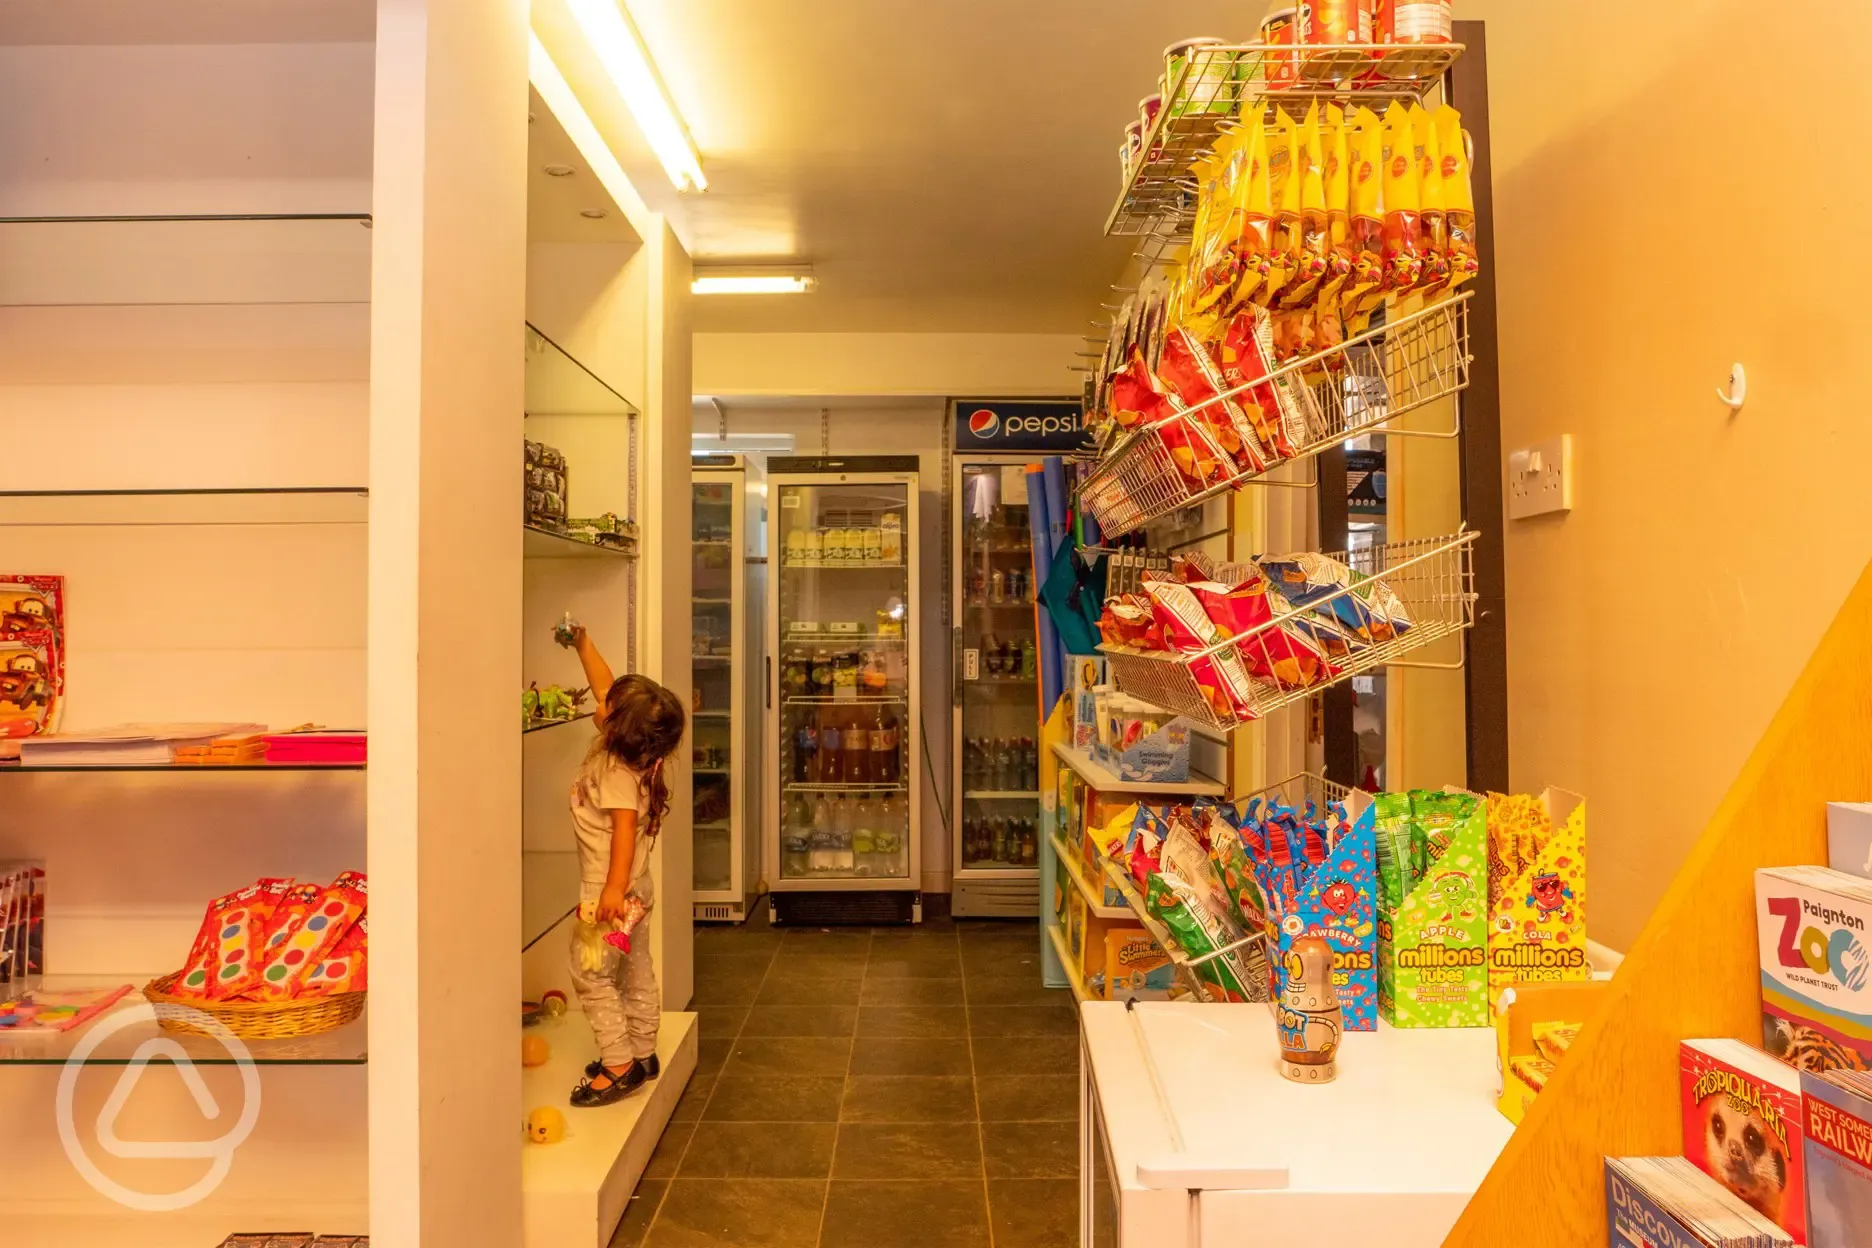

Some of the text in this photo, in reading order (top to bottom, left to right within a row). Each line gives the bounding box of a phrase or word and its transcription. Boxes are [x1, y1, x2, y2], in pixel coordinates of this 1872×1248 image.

[1005, 413, 1077, 437] pepsi
[1139, 751, 1174, 760] Swimming
[1803, 899, 1865, 931] Paignton
[1305, 928, 1362, 948] AWBERRY
[1419, 925, 1465, 941] APPLE
[1522, 930, 1552, 941] COLA
[1122, 942, 1151, 955] Little
[1399, 943, 1485, 968] millions
[1494, 943, 1584, 968] millions
[1419, 967, 1465, 983] tubes
[1515, 967, 1562, 981] tubes
[1786, 972, 1838, 991] WILD PLANET TRUST
[1416, 986, 1469, 995] The Tiny Tasty
[1416, 995, 1468, 1003] Chewy Sweets
[1277, 1005, 1305, 1031] BOT
[1693, 1070, 1791, 1159] TROPIQUARIA
[1727, 1095, 1750, 1115] ZOO
[1808, 1097, 1837, 1122] WEST
[1629, 1218, 1658, 1247] MUSEUM
